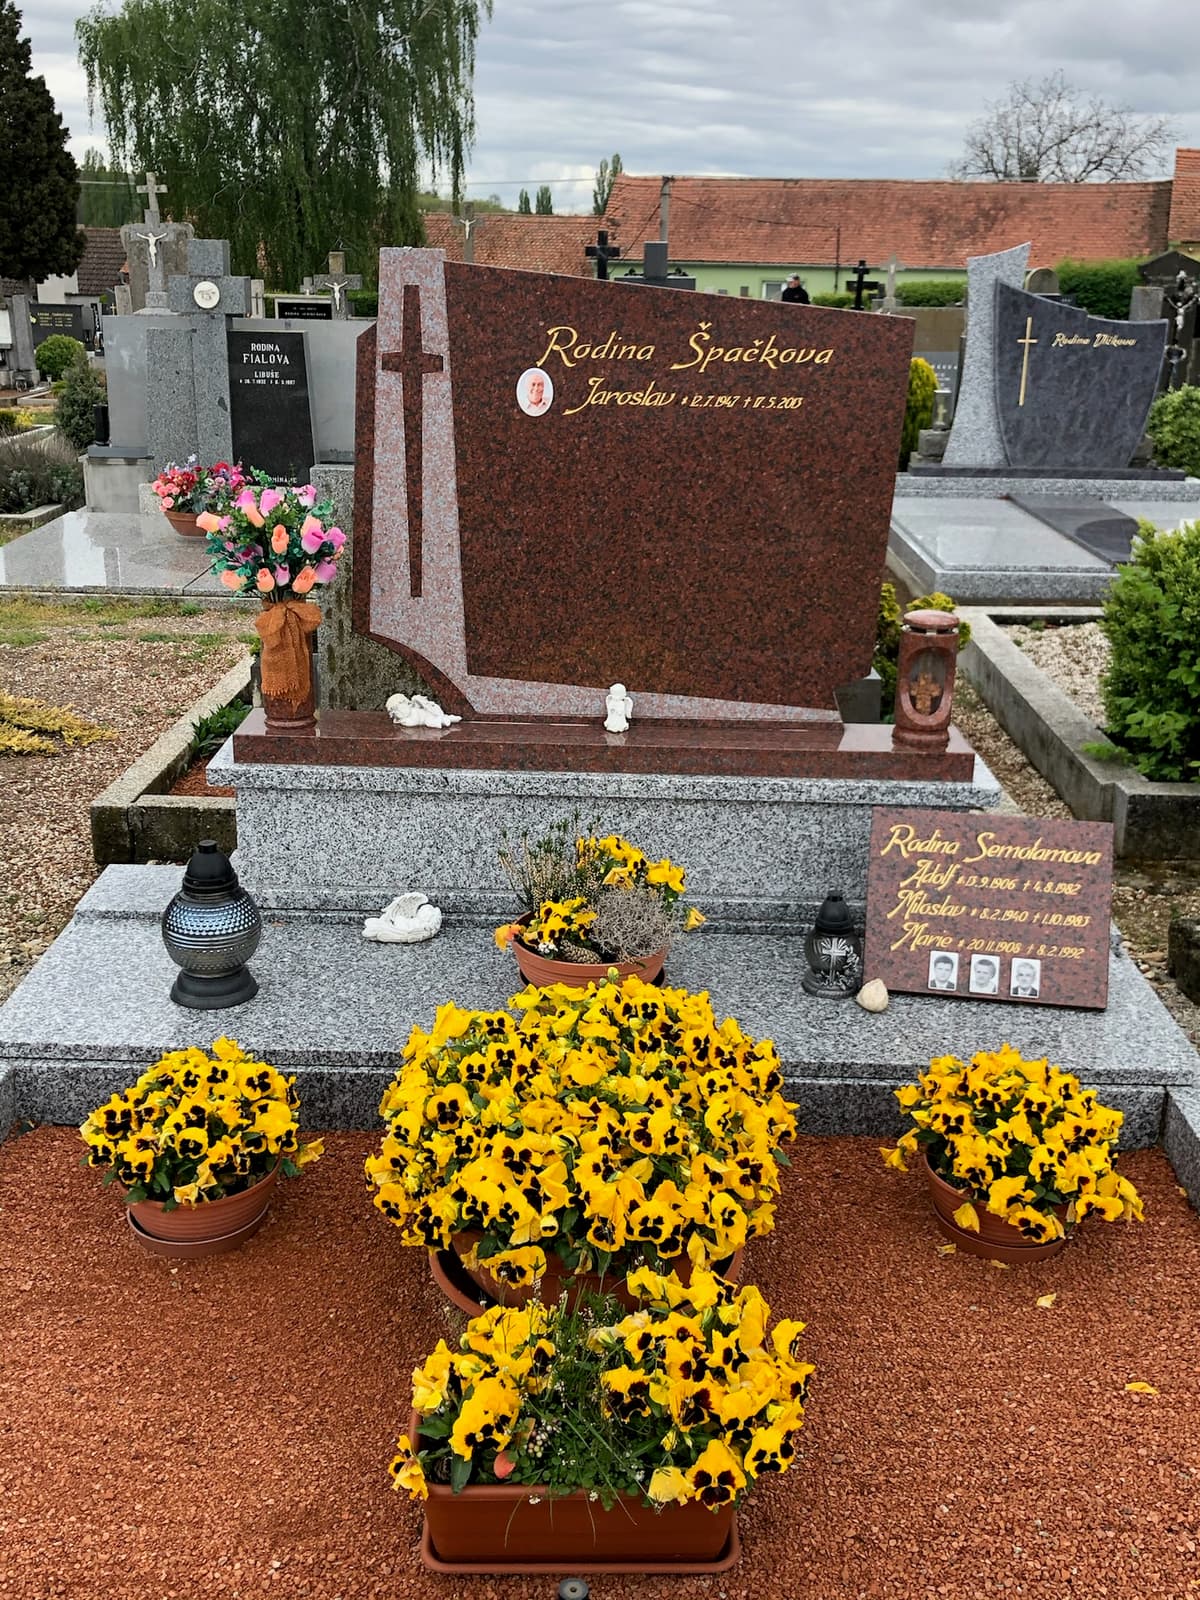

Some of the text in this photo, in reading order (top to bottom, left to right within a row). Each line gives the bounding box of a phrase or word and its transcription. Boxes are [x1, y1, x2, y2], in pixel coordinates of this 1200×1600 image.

[243, 353, 290, 365] FIALOVA
[251, 343, 280, 352] RODINA
[536, 322, 834, 373] Rodina Špačkova
[254, 369, 280, 379] LIBUŠE
[562, 377, 676, 415] Jaroslav
[880, 824, 961, 858] Rodina
[900, 859, 961, 891] Adolf
[887, 889, 967, 920] Miloslav
[890, 921, 953, 952] Marie
